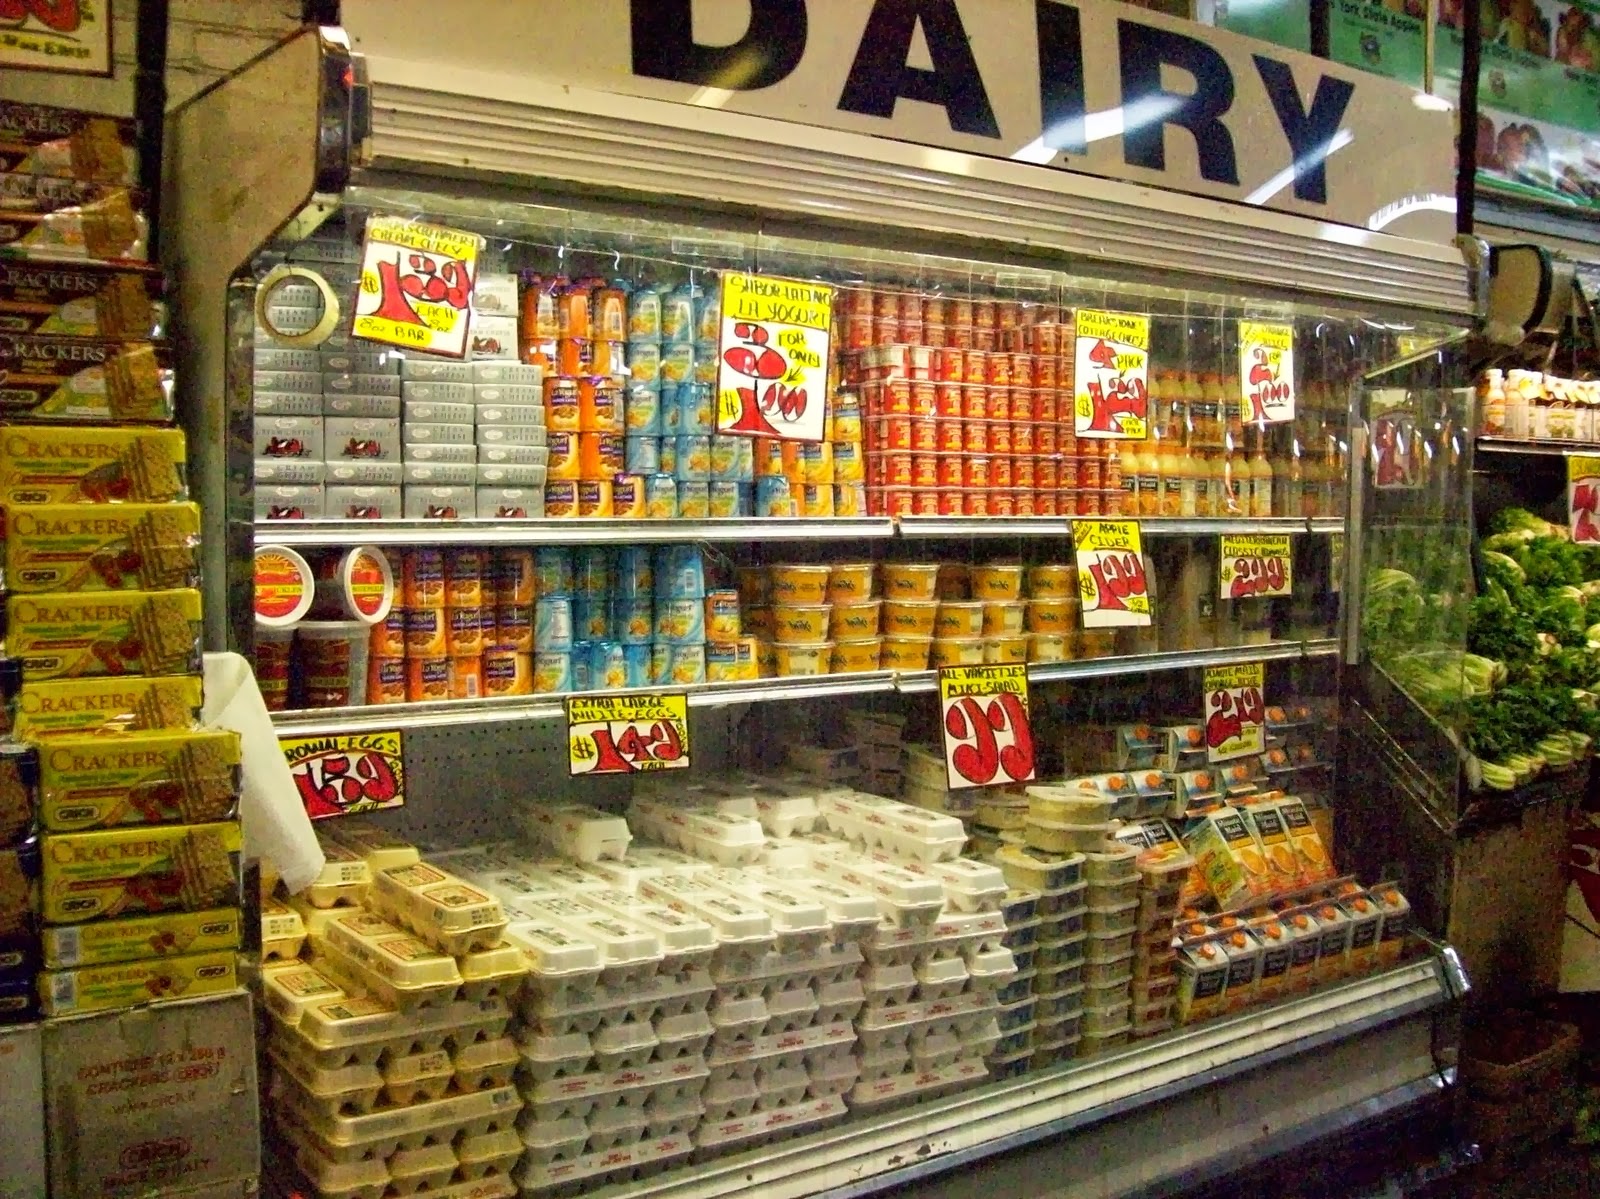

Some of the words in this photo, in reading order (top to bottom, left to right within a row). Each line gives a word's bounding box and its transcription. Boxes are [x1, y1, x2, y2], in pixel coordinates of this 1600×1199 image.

[630, 0, 1356, 206] DAIRY
[738, 298, 760, 318] LA
[768, 302, 828, 329] YOGURT
[394, 326, 426, 341] BAR
[778, 332, 807, 347] FOR
[6, 435, 121, 458] CRACKERS
[14, 512, 131, 536] CRACKERS
[1089, 534, 1130, 547] CIDER
[15, 600, 132, 623] CRACKERS
[20, 691, 137, 714] CRACKERS
[51, 749, 168, 771] CRACKERS
[52, 839, 172, 864] CRACKERS
